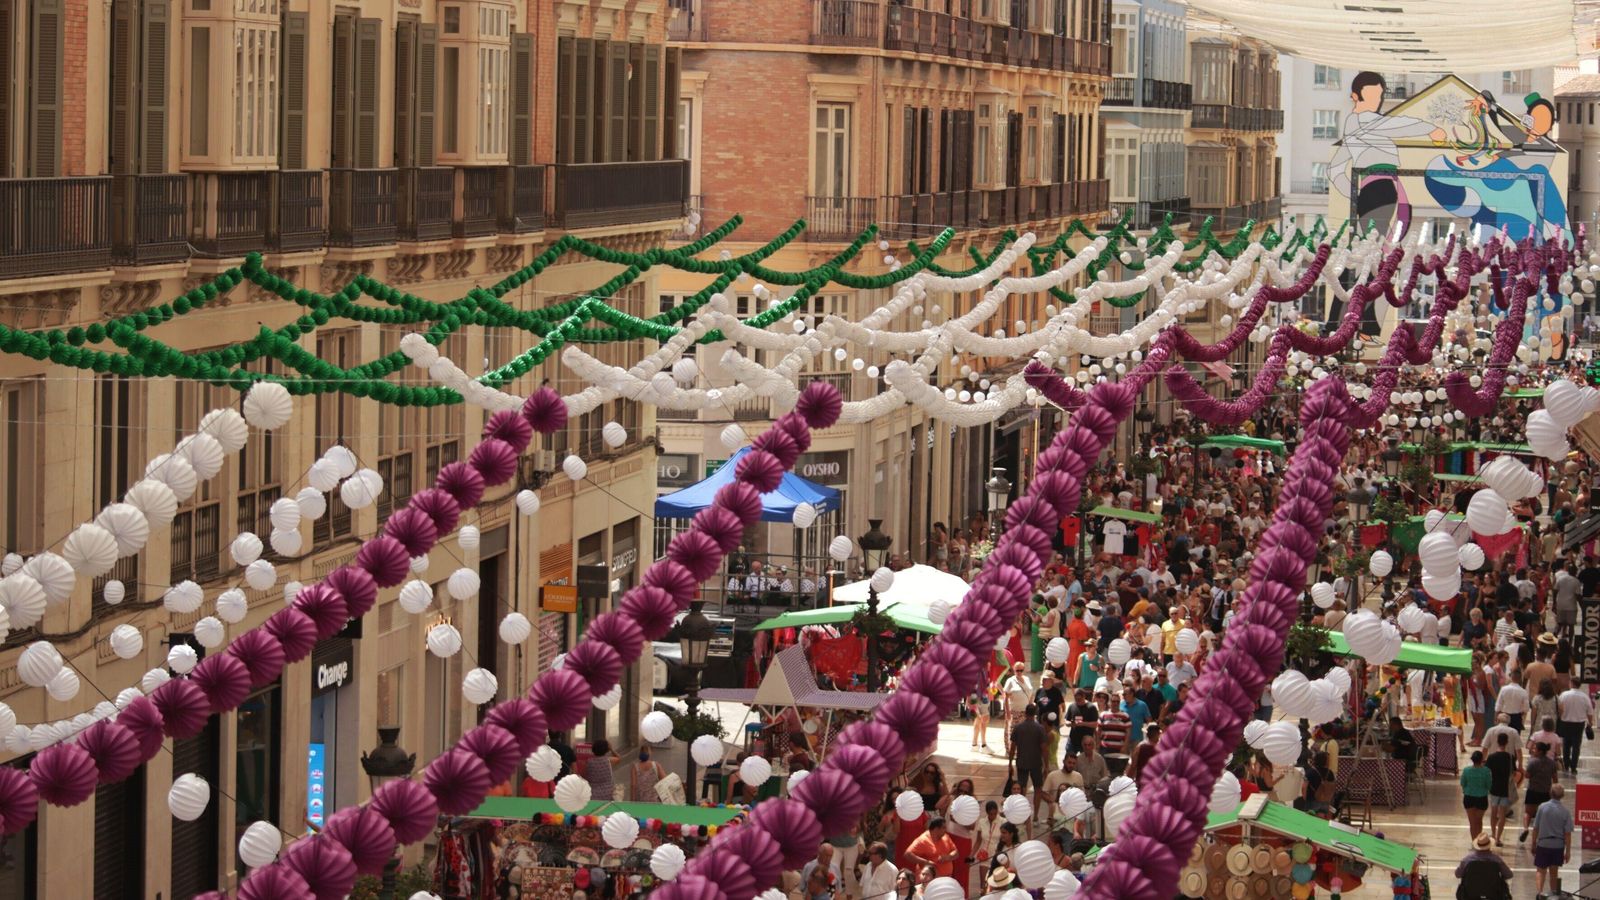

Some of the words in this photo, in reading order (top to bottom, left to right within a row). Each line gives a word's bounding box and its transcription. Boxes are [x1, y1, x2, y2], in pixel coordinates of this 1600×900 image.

[803, 462, 840, 477] OYSHO
[1584, 604, 1600, 680] PRIMOR
[318, 661, 348, 689] Change
